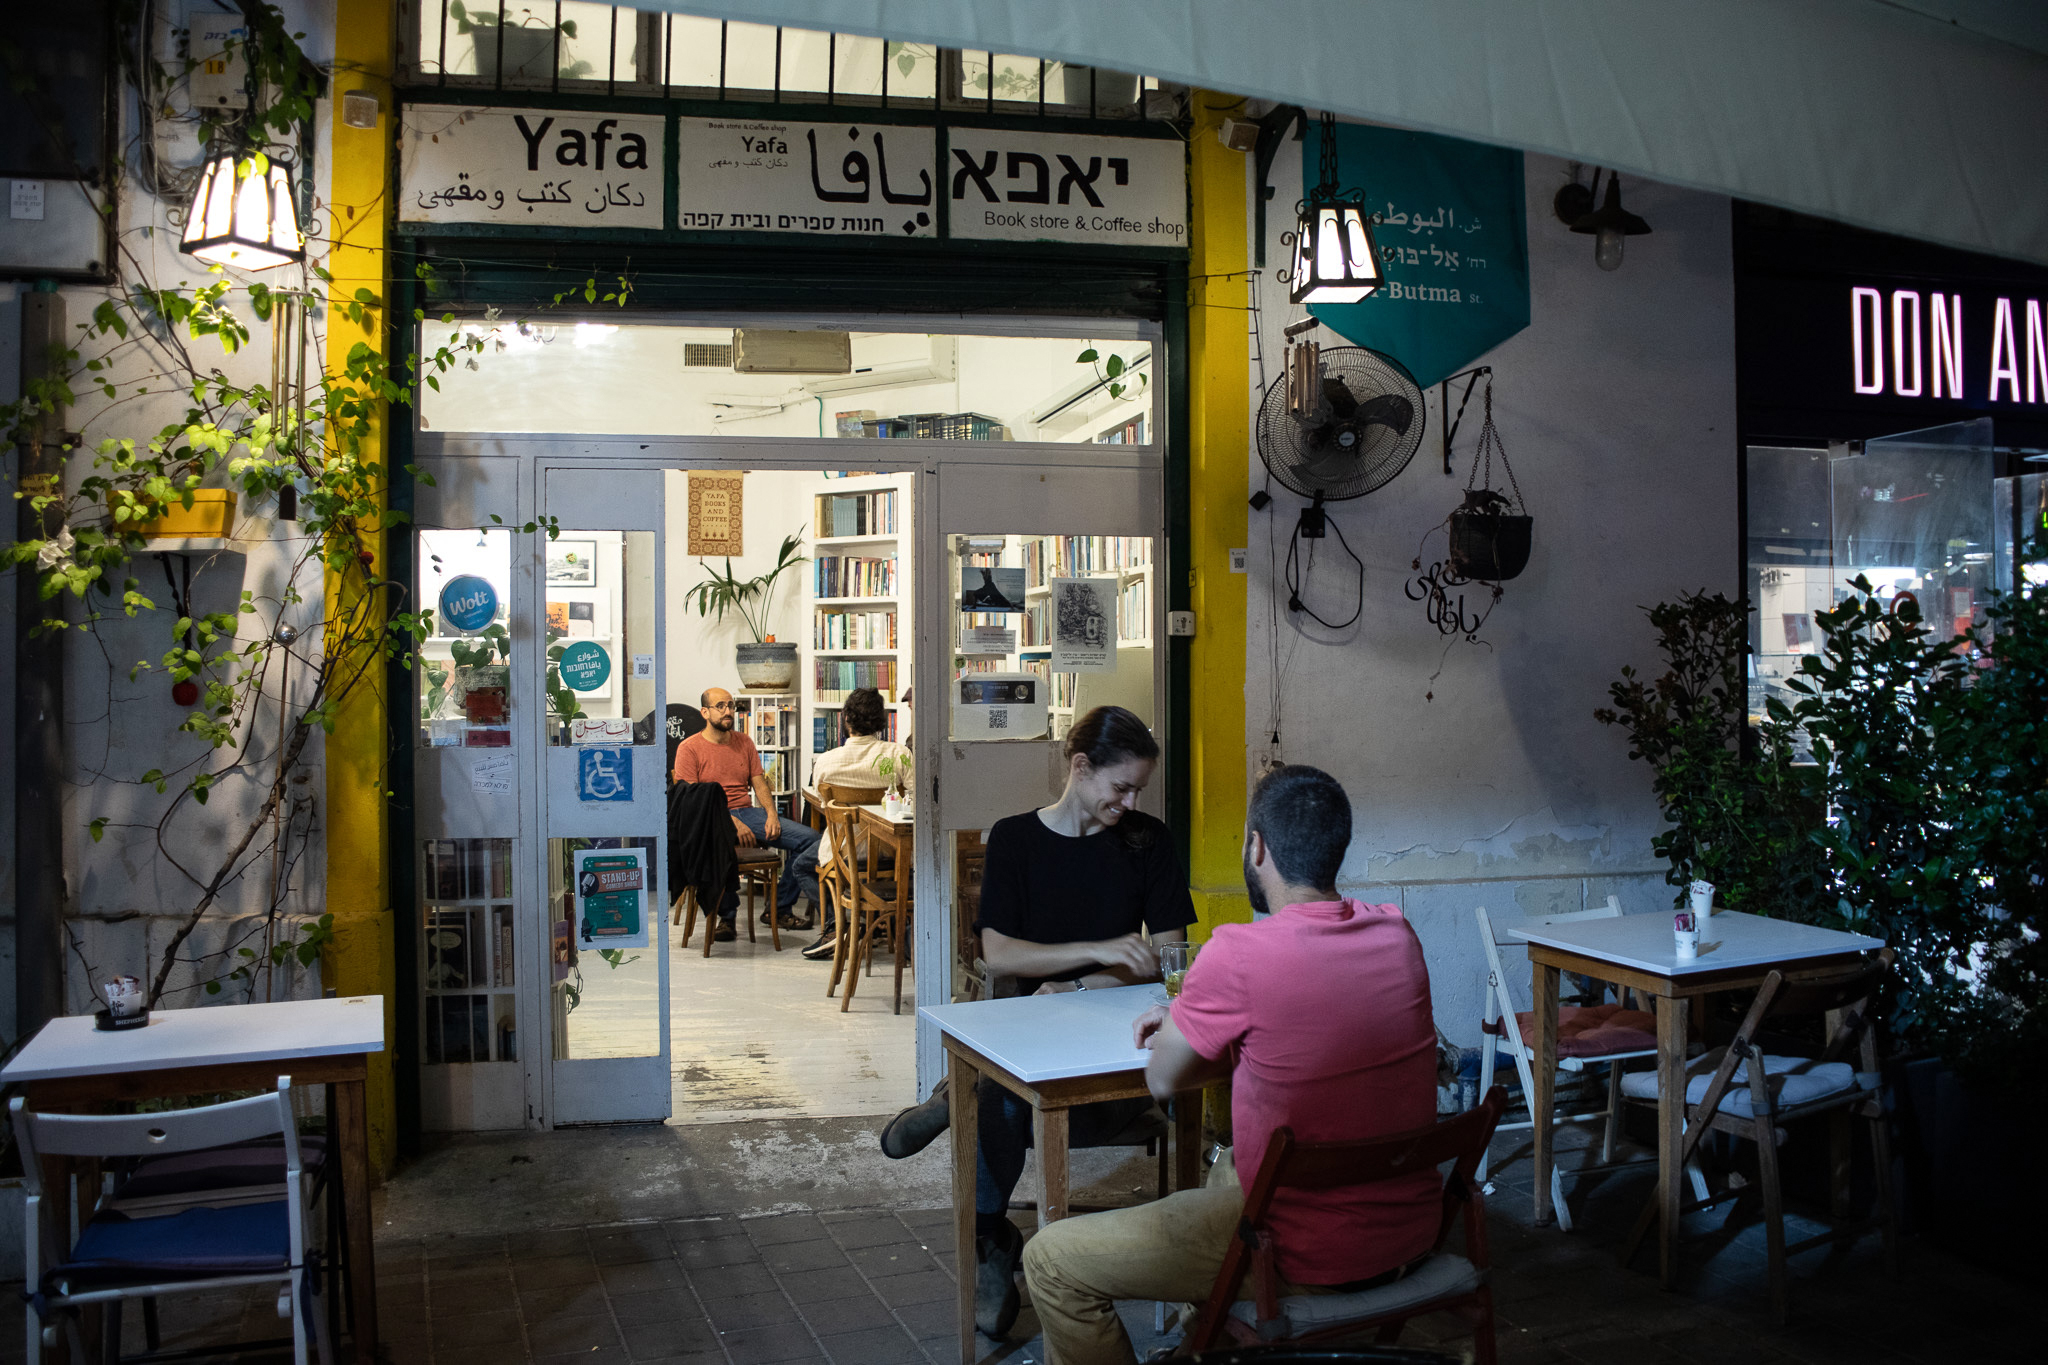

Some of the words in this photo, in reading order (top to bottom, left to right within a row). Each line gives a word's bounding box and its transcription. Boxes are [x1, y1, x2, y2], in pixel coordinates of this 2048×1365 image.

[771, 124, 787, 135] shop
[514, 115, 649, 171] Yafa
[741, 136, 788, 154] Yafa
[743, 157, 762, 168] كتب
[765, 158, 788, 169] دكان
[807, 126, 932, 235] يافا
[951, 148, 1130, 209] יאפא
[517, 180, 572, 213] كتب
[585, 182, 645, 214] دكان
[683, 212, 724, 230] קפה
[730, 213, 771, 229] ובית
[778, 215, 836, 231] ספרים
[841, 217, 884, 232] חנות
[984, 211, 1027, 229] Book
[1030, 213, 1070, 230] store
[1075, 215, 1090, 231] &
[1091, 216, 1142, 233] Coffee
[1147, 216, 1184, 241] shop
[1469, 293, 1484, 304] St.
[1851, 286, 1964, 400] DON
[449, 591, 490, 616] Wolt
[577, 649, 600, 662] شوارع
[580, 670, 596, 679] יאפא
[601, 871, 640, 884] STAND-UP
